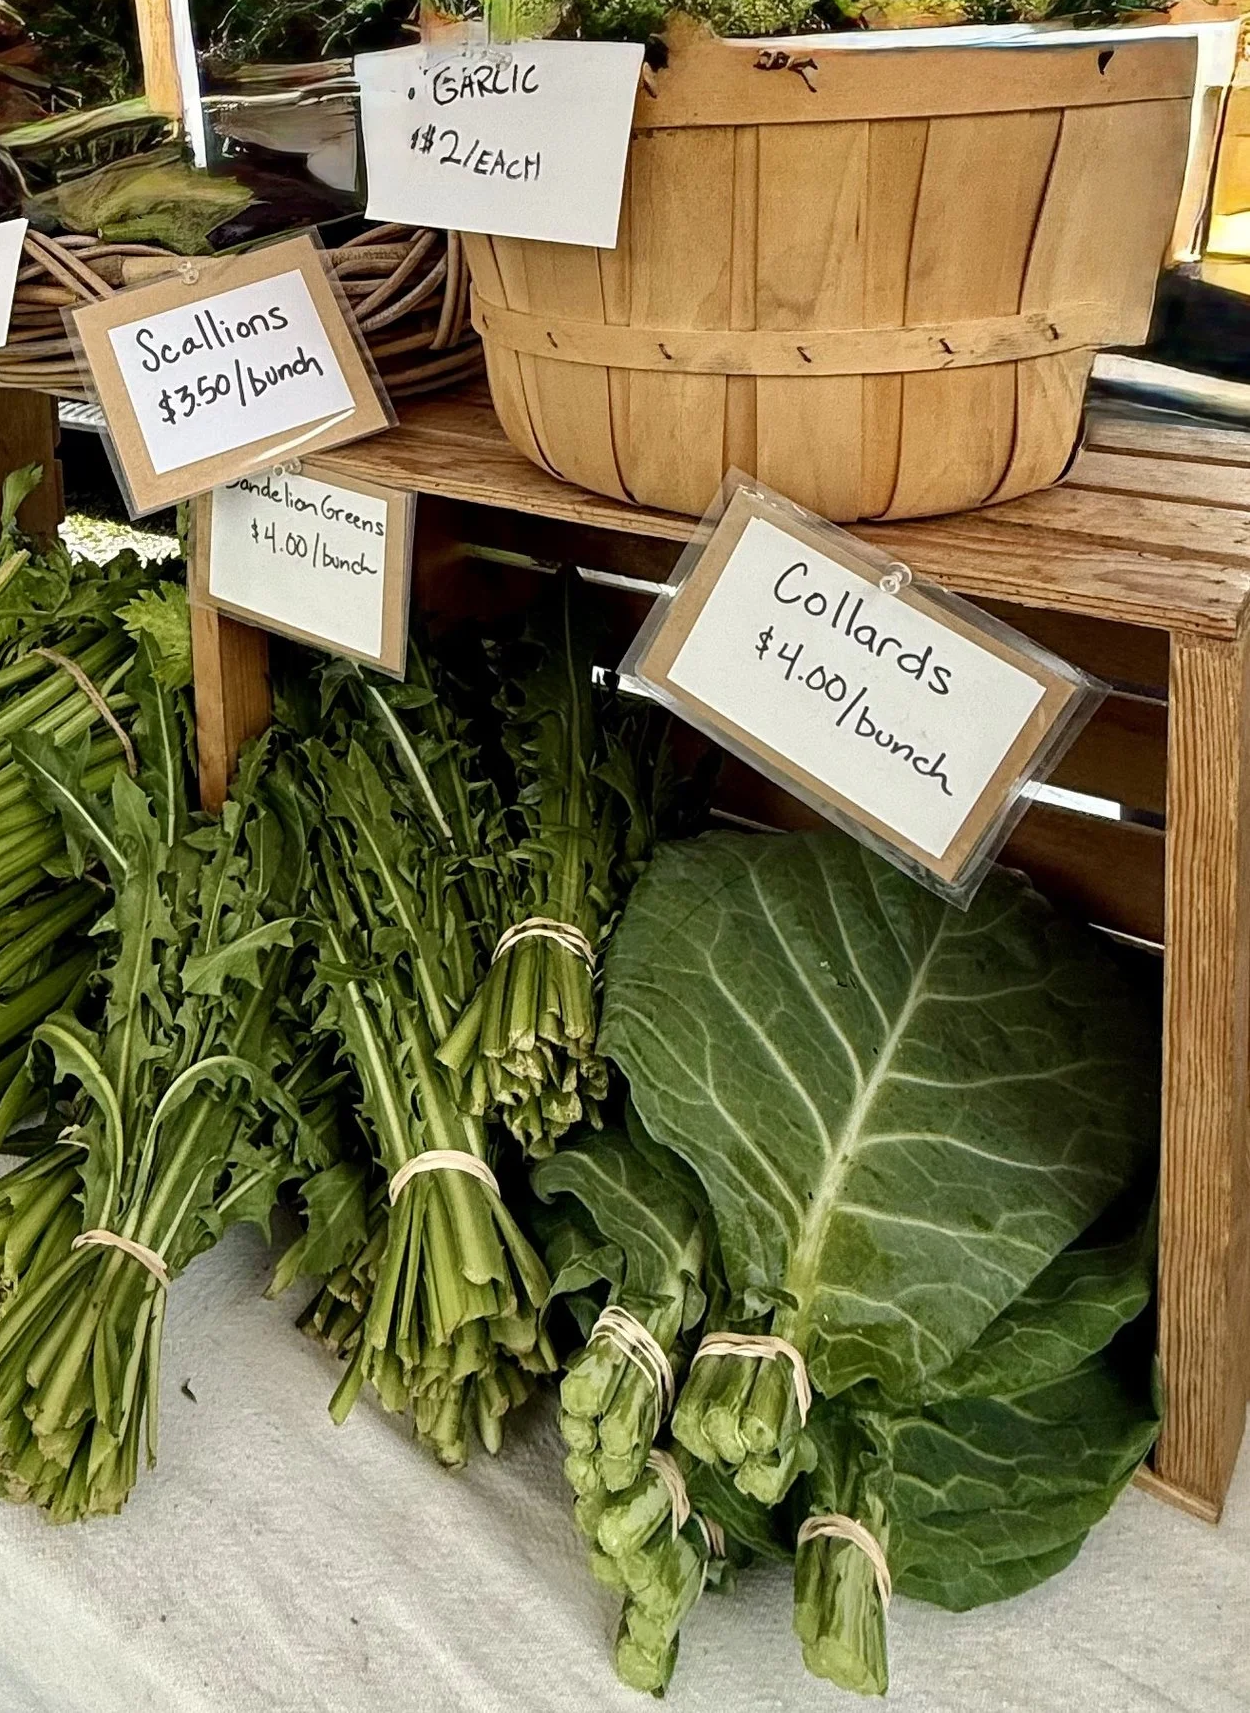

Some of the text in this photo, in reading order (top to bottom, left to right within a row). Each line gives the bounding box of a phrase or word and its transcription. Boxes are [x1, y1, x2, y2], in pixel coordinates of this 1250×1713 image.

[433, 64, 540, 106] GARLIC
[135, 305, 289, 372] Scallions
[158, 346, 324, 425] $3.50/bunch
[226, 476, 385, 536] andelion Greens
[773, 562, 952, 695] Collards
